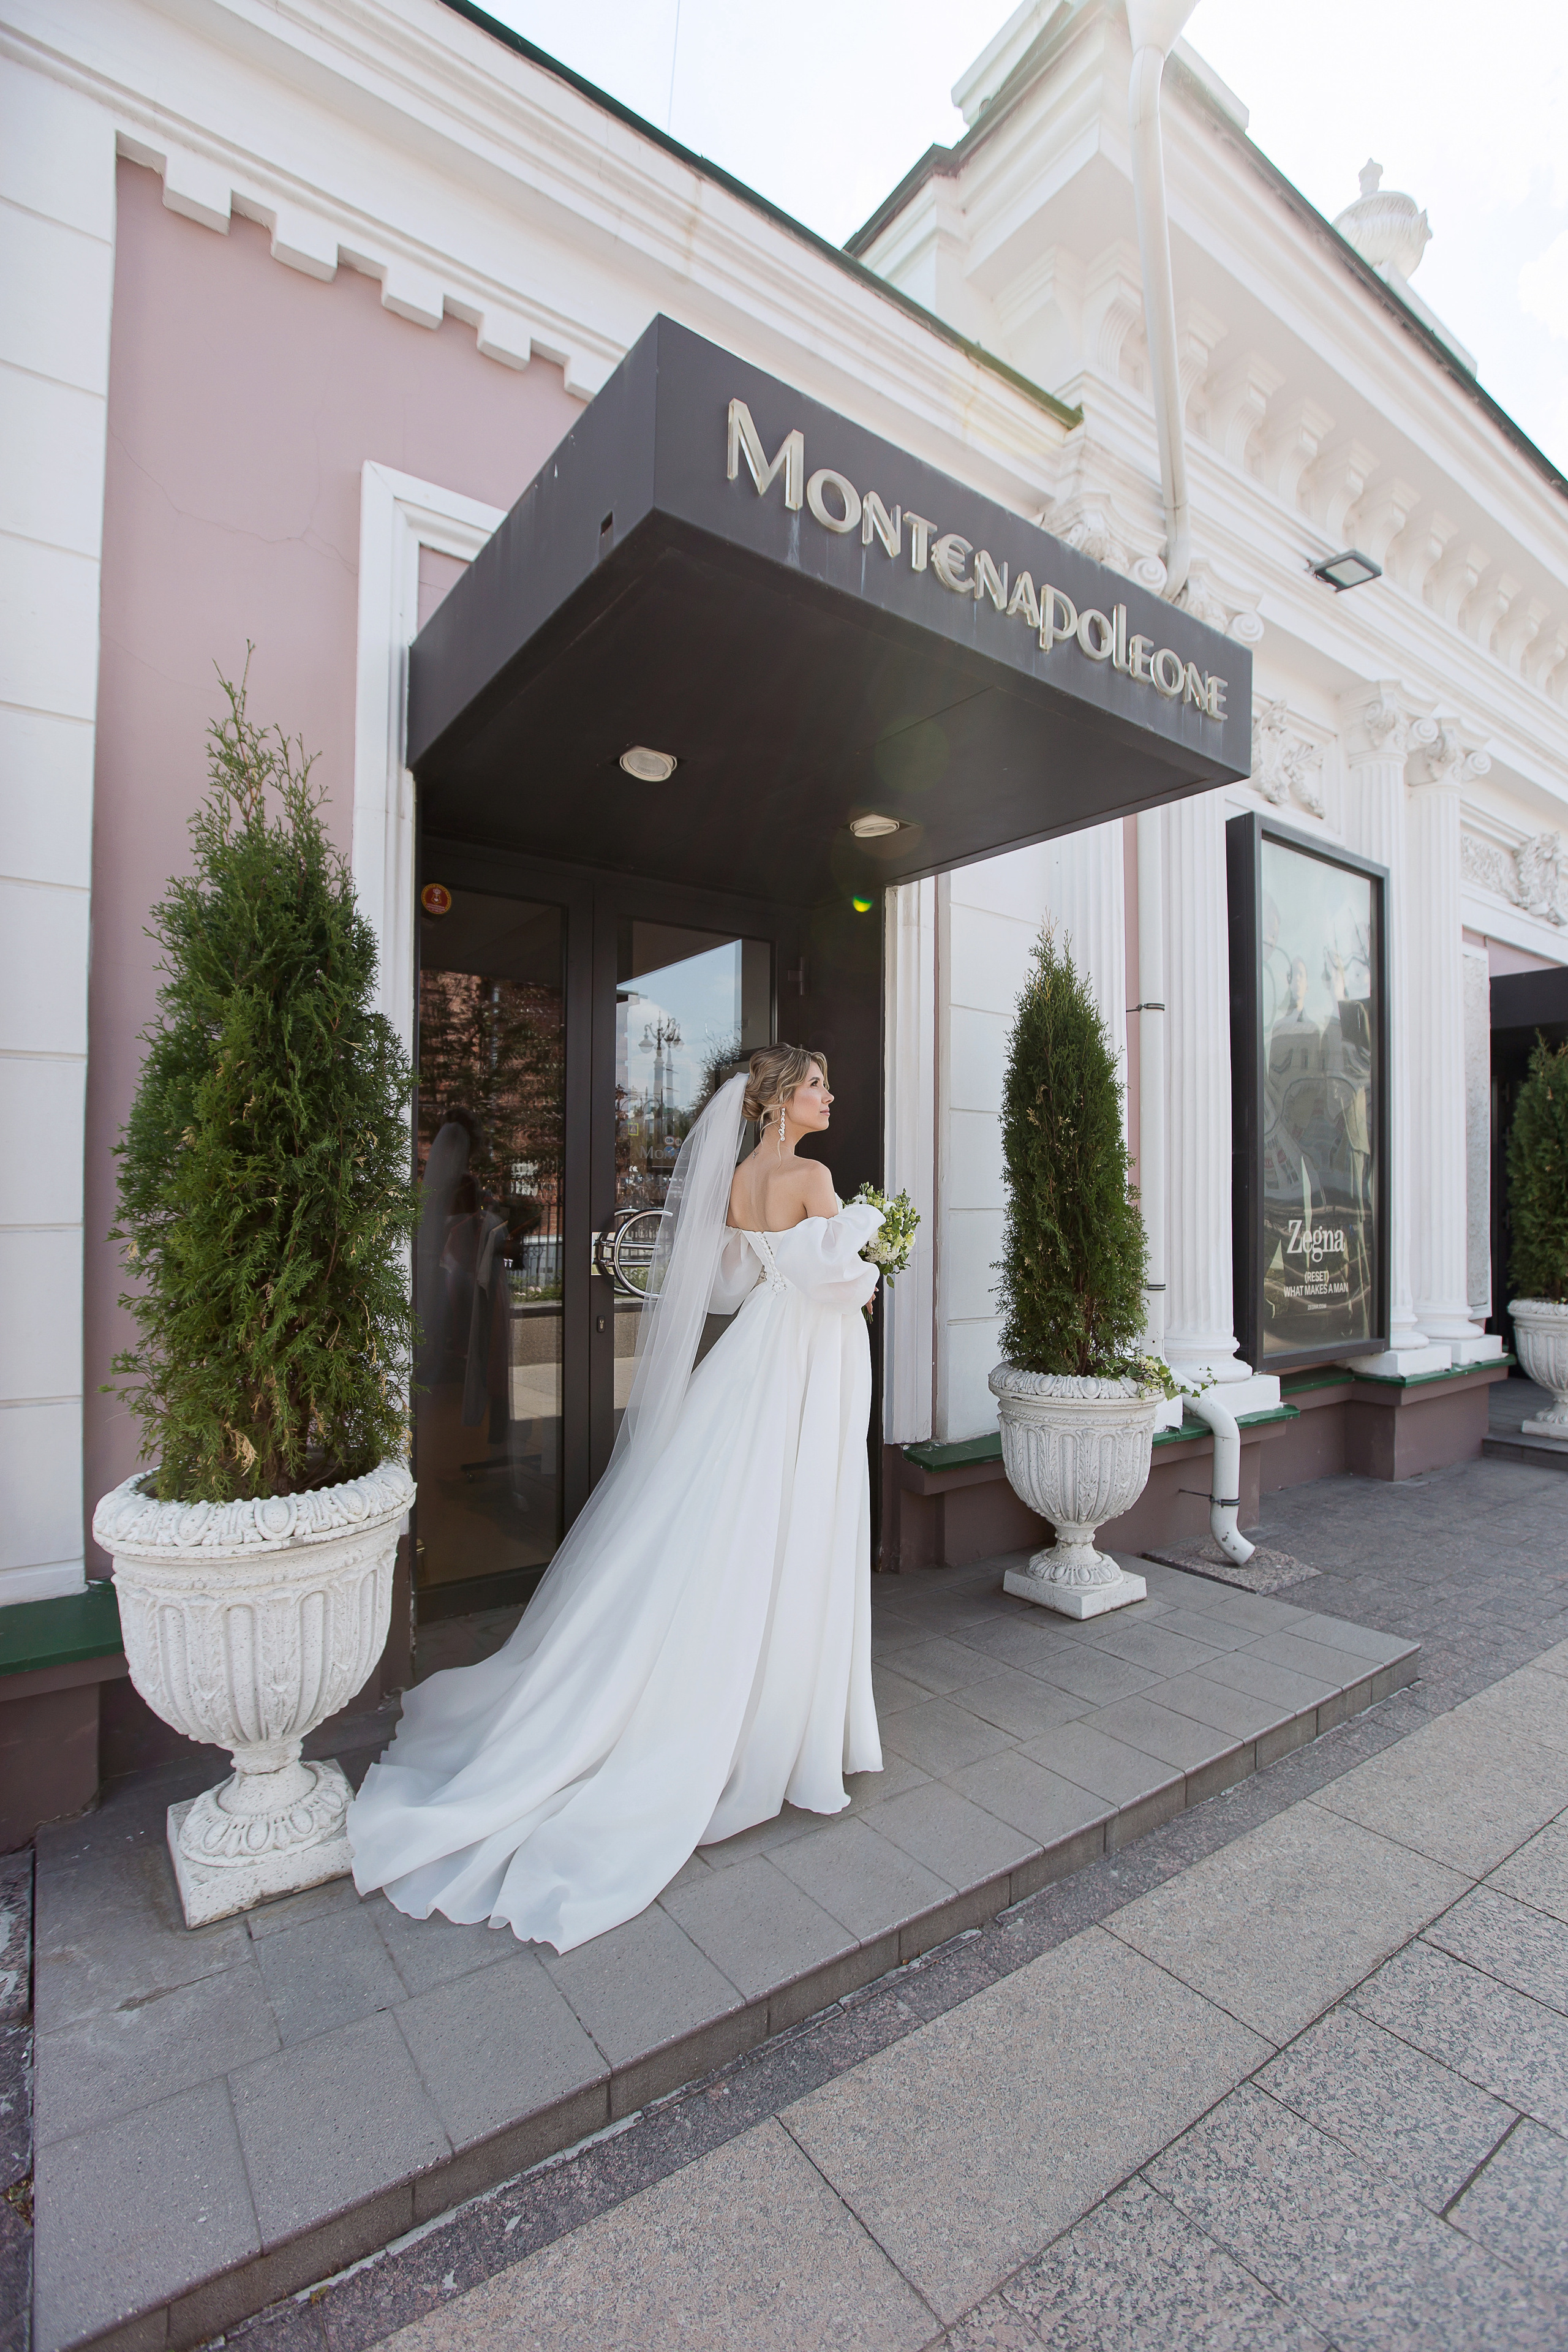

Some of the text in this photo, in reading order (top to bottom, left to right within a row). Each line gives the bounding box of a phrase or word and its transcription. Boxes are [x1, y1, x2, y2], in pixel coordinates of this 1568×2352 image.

[1287, 1219, 1346, 1263] Zegna
[1305, 1270, 1329, 1283] (RESET)
[1284, 1282, 1349, 1297] WHAT MAKES A MAN
